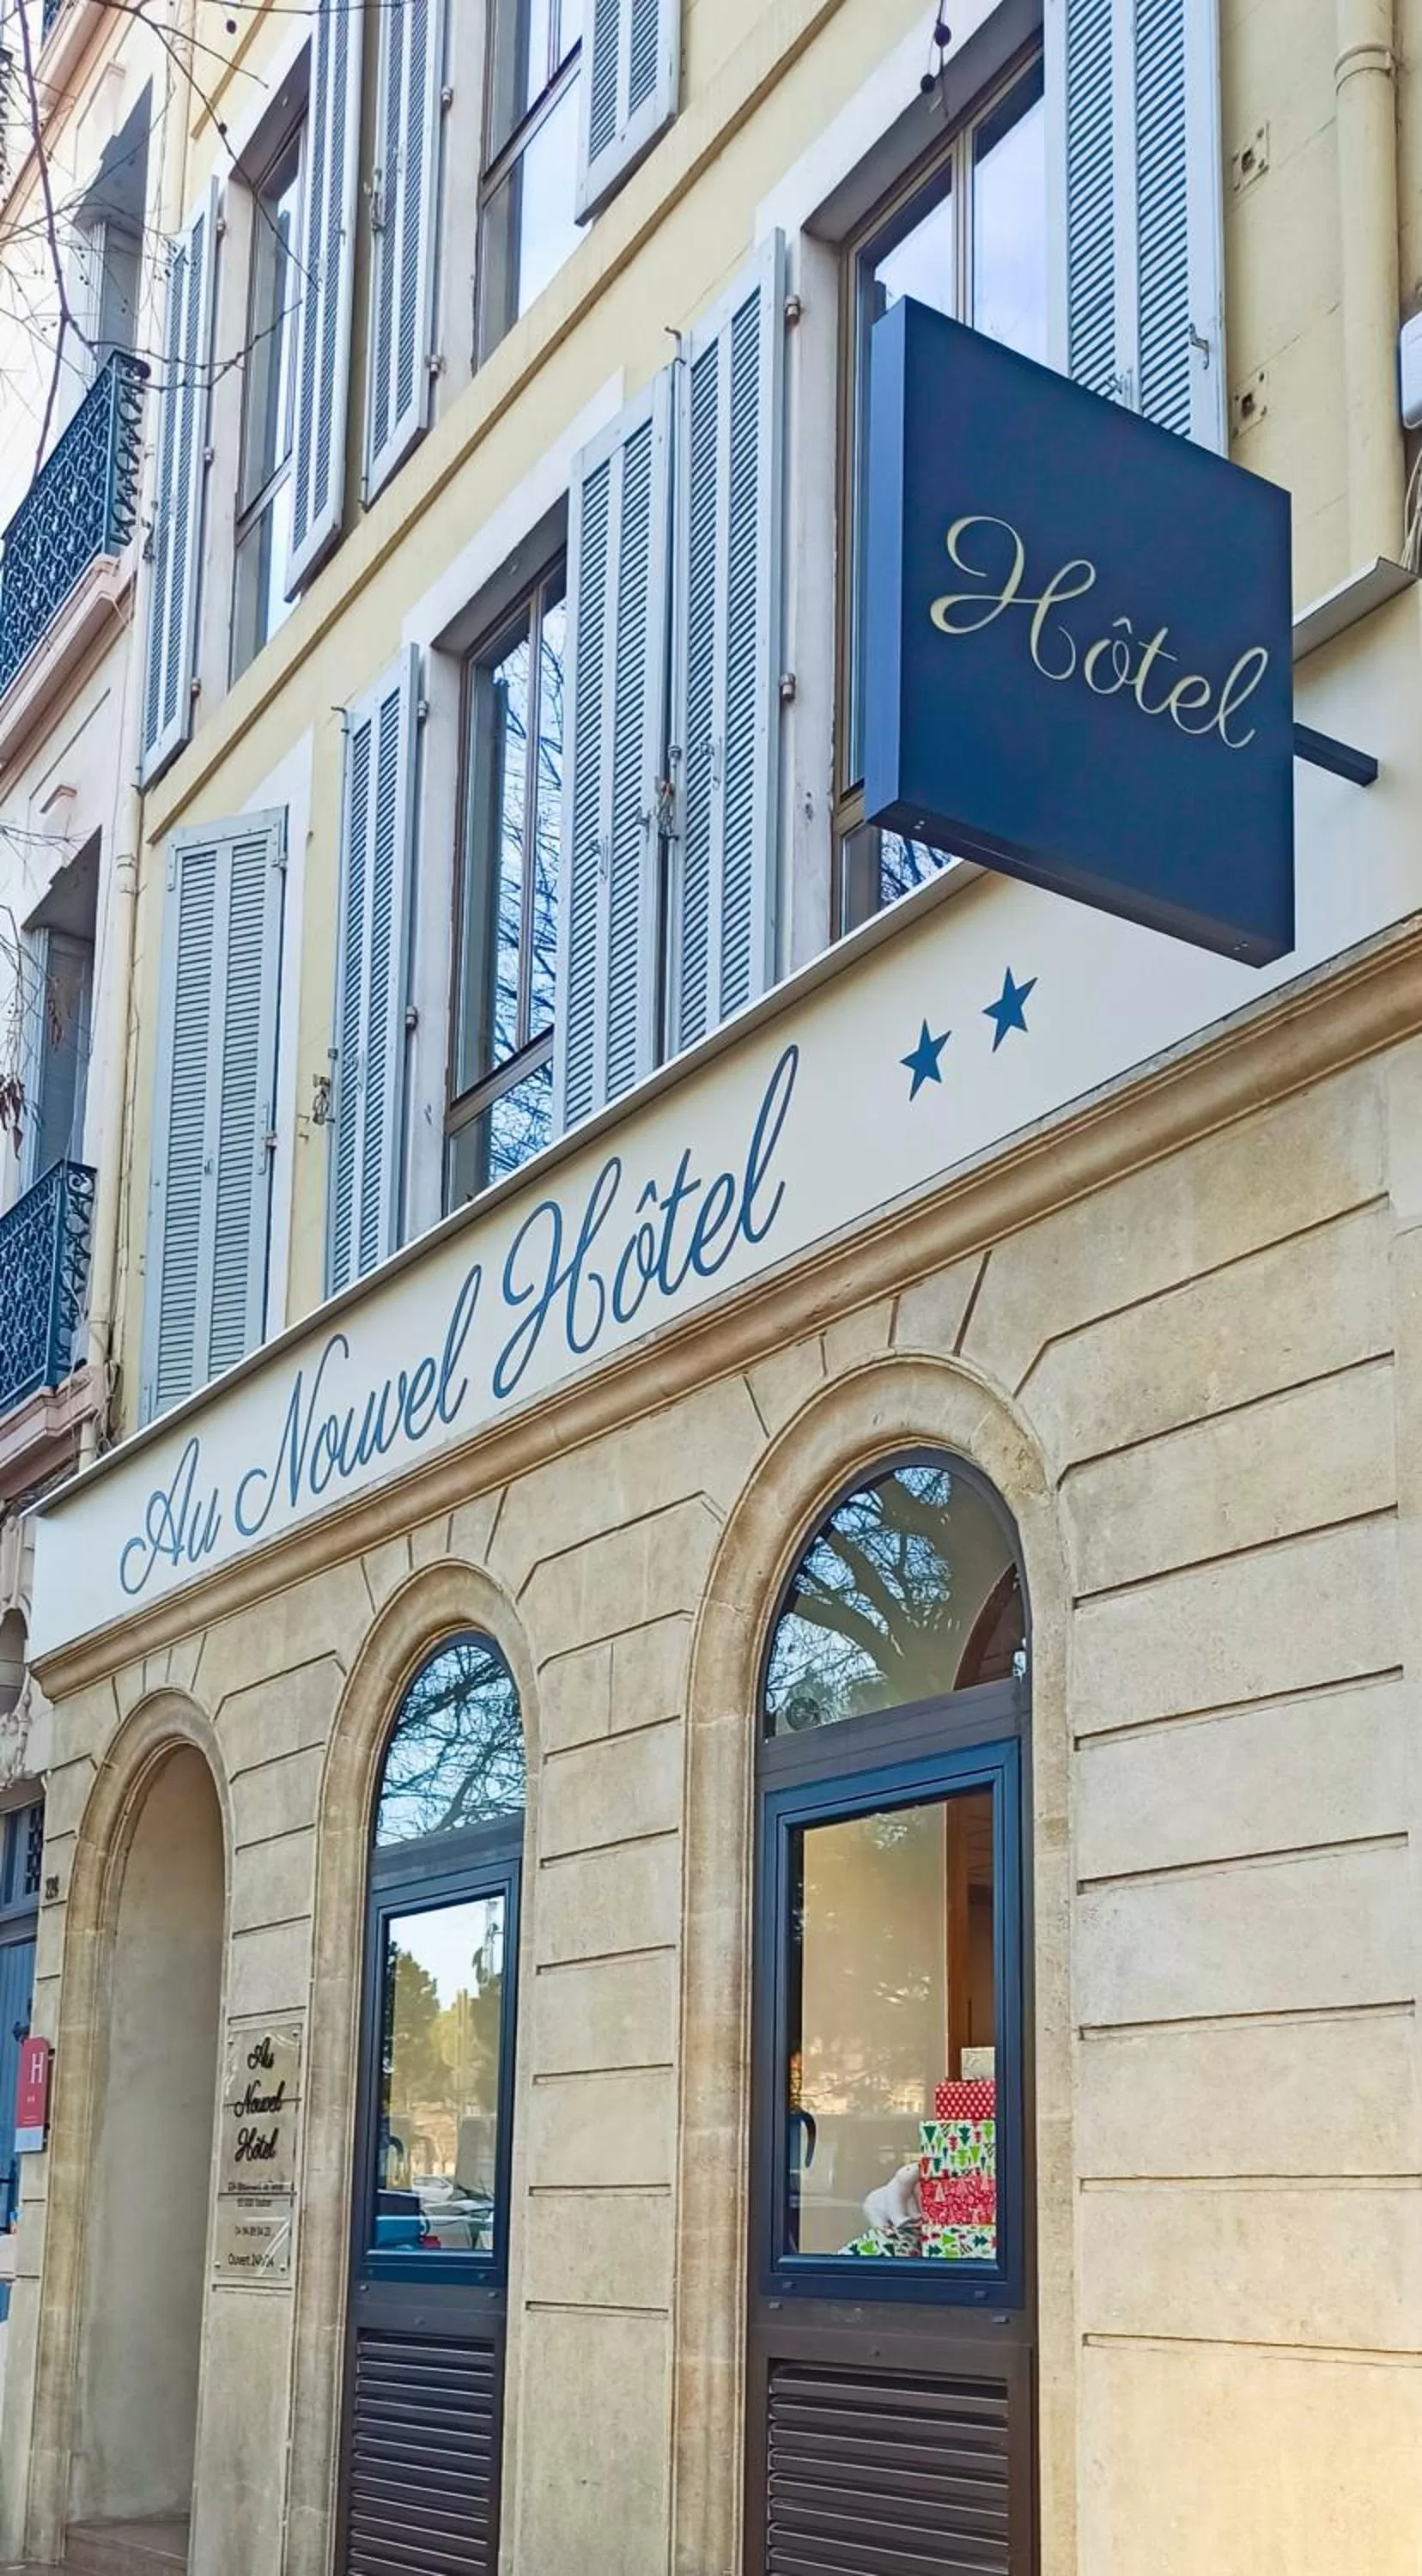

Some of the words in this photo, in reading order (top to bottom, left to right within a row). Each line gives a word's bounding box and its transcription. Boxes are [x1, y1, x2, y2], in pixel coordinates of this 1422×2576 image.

[930, 515, 1268, 750] Hôtel
[119, 1436, 222, 1595] Au
[234, 1263, 483, 1537] Nouvel
[492, 1043, 799, 1400] Hôtel
[30, 2051, 46, 2085] H
[234, 2126, 280, 2163] Hôtel
